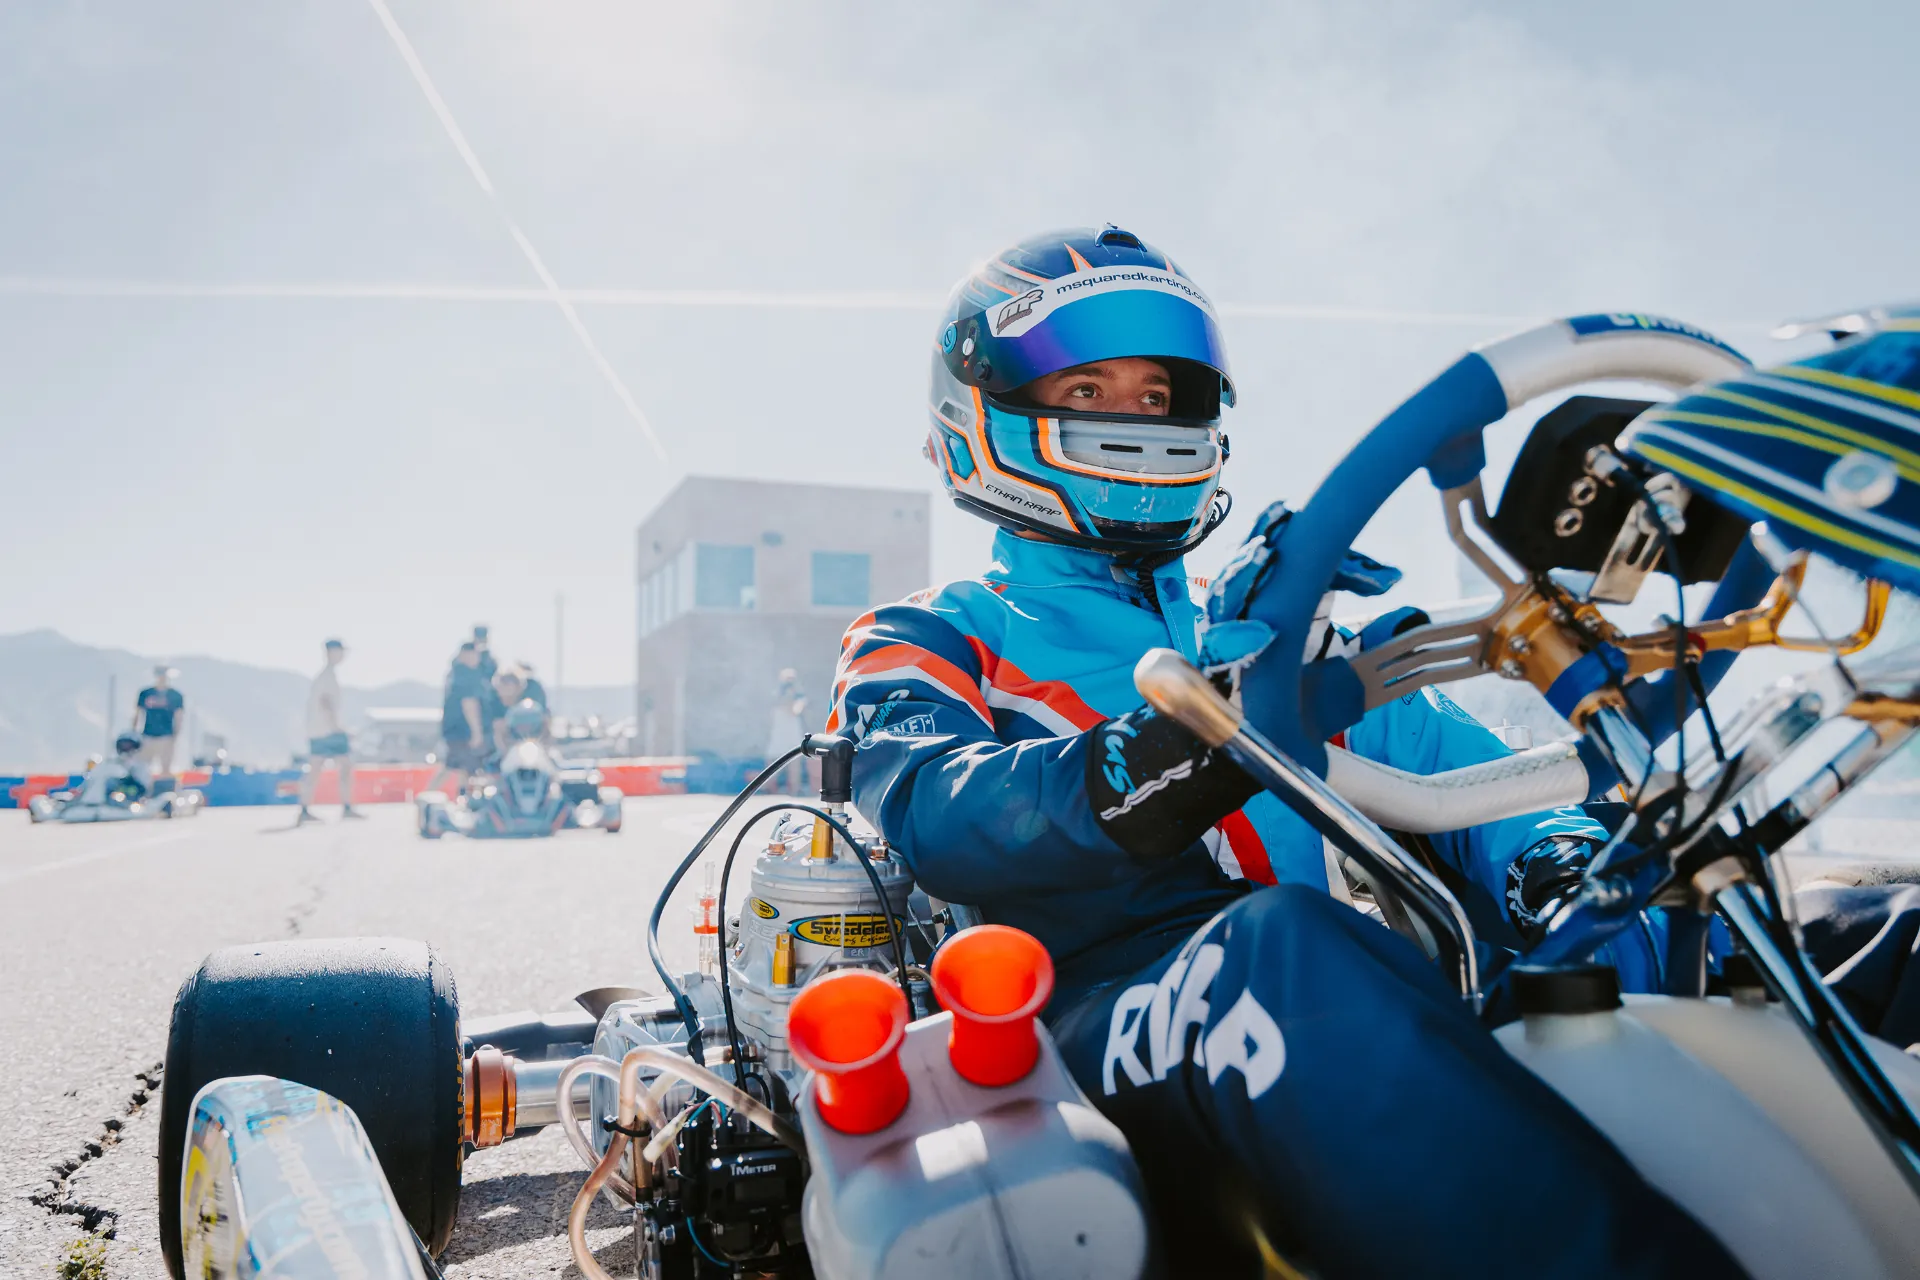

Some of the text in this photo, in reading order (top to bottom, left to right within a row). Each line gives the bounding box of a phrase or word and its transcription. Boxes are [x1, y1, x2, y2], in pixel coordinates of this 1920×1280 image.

[1056, 272, 1213, 312] msquaredkarting.com
[985, 484, 1062, 516] ETHAN RAAP
